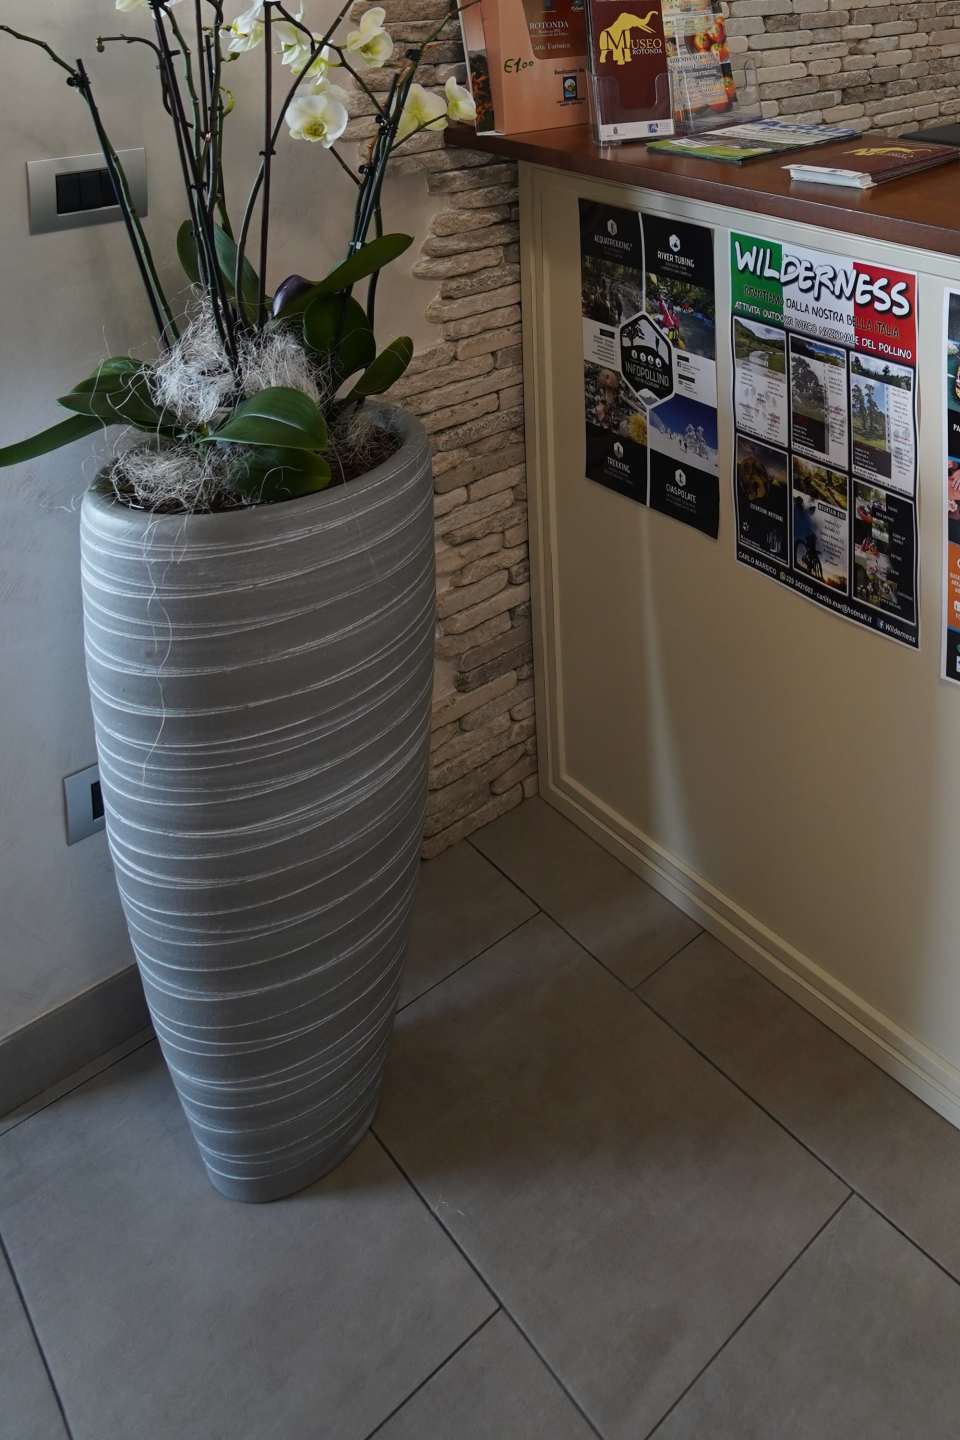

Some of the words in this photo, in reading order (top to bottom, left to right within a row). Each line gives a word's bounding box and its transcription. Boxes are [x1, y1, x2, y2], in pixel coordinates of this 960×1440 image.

[529, 21, 568, 30] ROTONDA
[604, 29, 662, 49] MUSEO
[658, 251, 674, 262] RIVER
[675, 256, 694, 268] TUBING
[734, 240, 911, 317] WILDERNESS
[786, 298, 810, 315] DALLA
[811, 307, 845, 323] NOSTRA
[846, 313, 873, 331] BELLA
[875, 320, 900, 337] ITALIA
[861, 338, 876, 351] DEL
[878, 344, 912, 360] POLLINO
[625, 362, 669, 386] INFOPOLLINO
[885, 623, 916, 643] Wilderness
